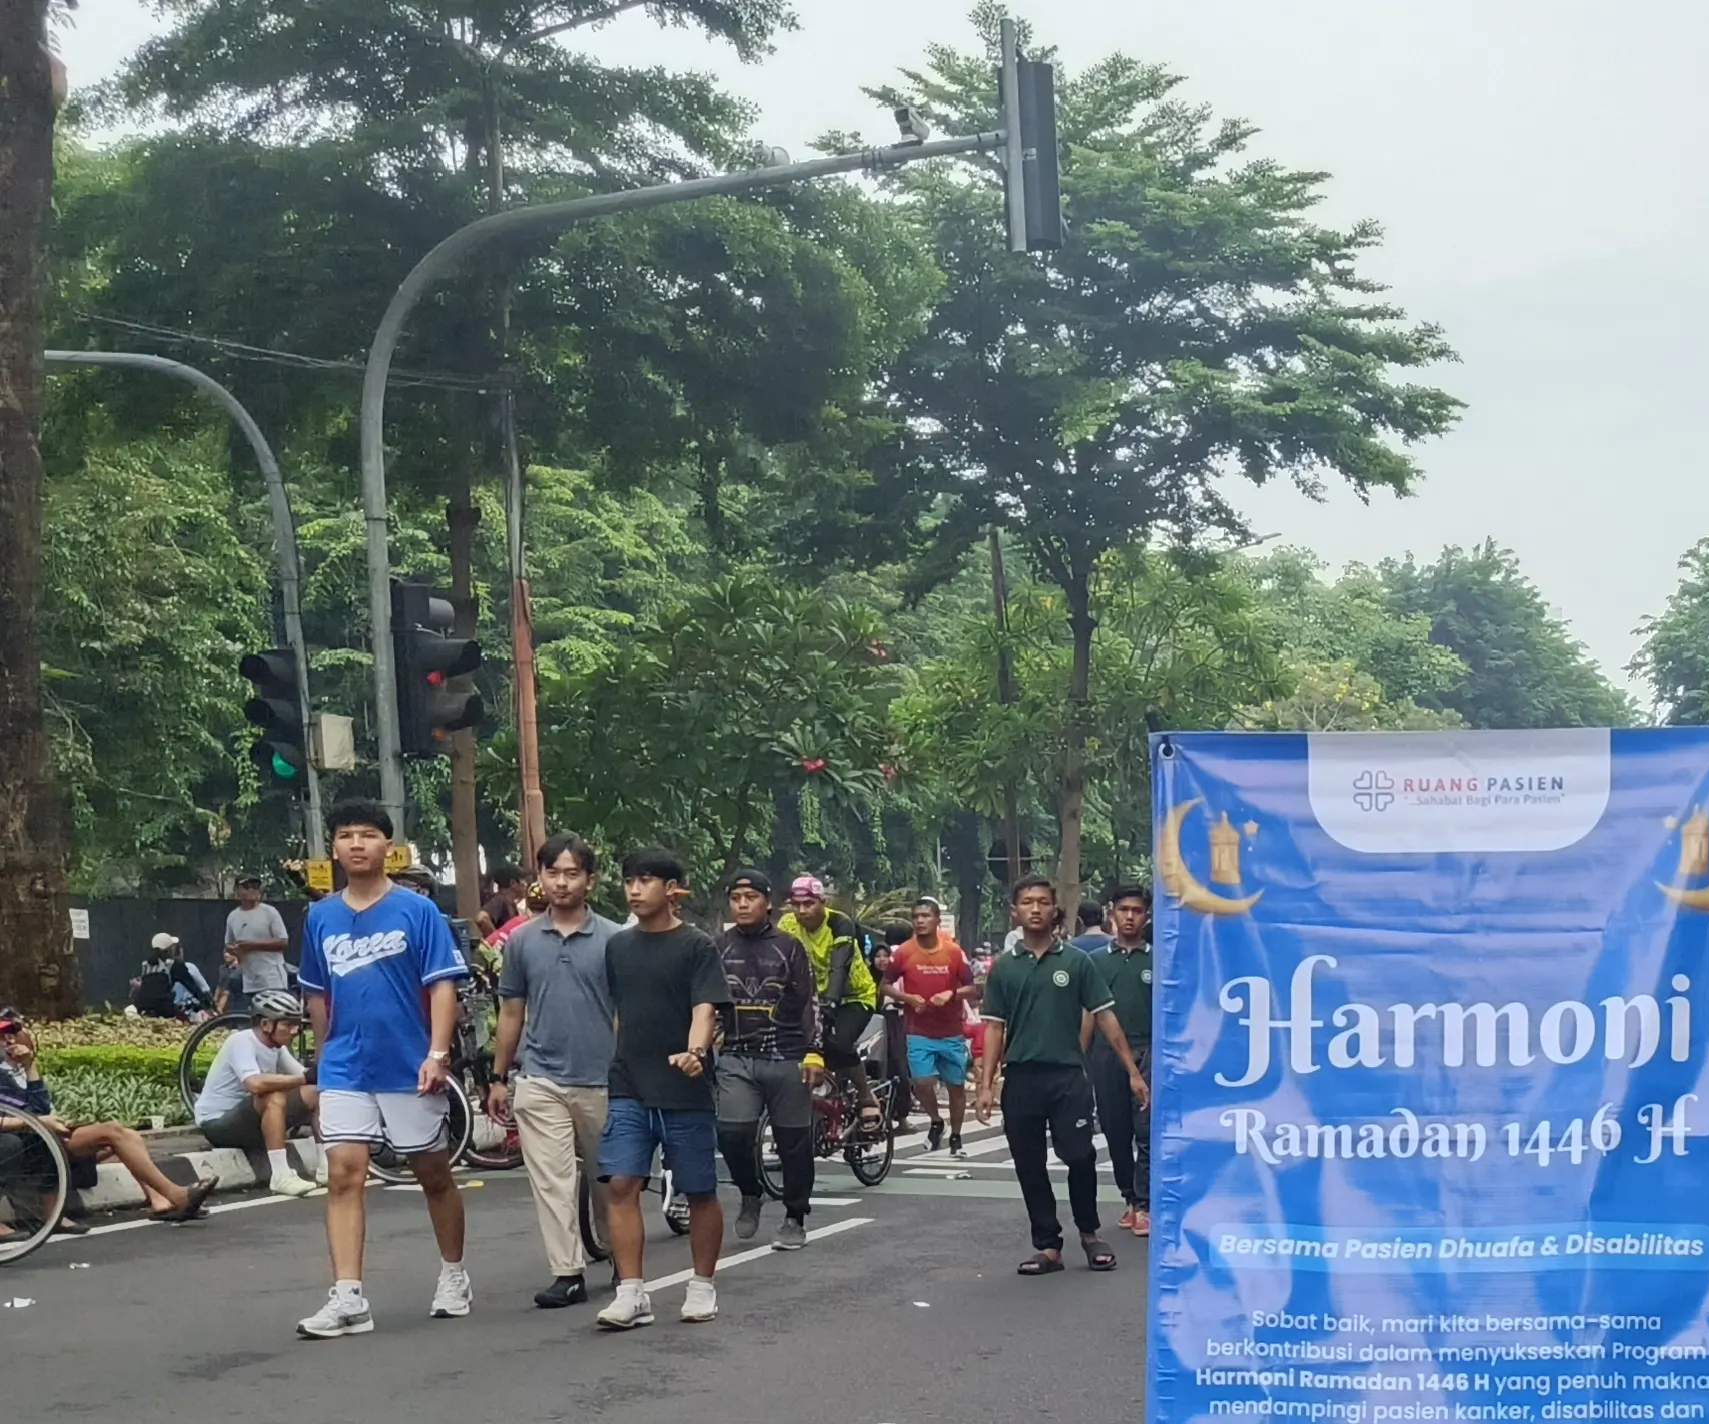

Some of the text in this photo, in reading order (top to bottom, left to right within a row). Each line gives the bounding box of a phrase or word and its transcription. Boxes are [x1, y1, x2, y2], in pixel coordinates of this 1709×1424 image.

[1403, 776, 1564, 792] RUANG PASIEN
[1466, 795, 1491, 808] Bagi
[1494, 794, 1520, 805] Para
[322, 930, 408, 976] Korea
[1214, 954, 1691, 1087] Harmoni
[1219, 1093, 1699, 1167] Ramadan 1446 H
[1219, 1232, 1705, 1259] Bersama Pasien Dhuafa & Disabilitas
[1252, 1310, 1661, 1335] Sobat baik, mari kita bersama-sama
[1206, 1338, 1707, 1366] berkontribusi dalam menyukseskan Program
[1195, 1367, 1294, 1387] Harmoni
[1300, 1371, 1411, 1391] Ramadan
[1417, 1373, 1468, 1391] 1446
[1474, 1374, 1489, 1391] H
[1494, 1375, 1551, 1396] yang
[1557, 1372, 1626, 1395] penuh
[1209, 1396, 1704, 1424] mendampingi pasien kanker, disabilitas dan
